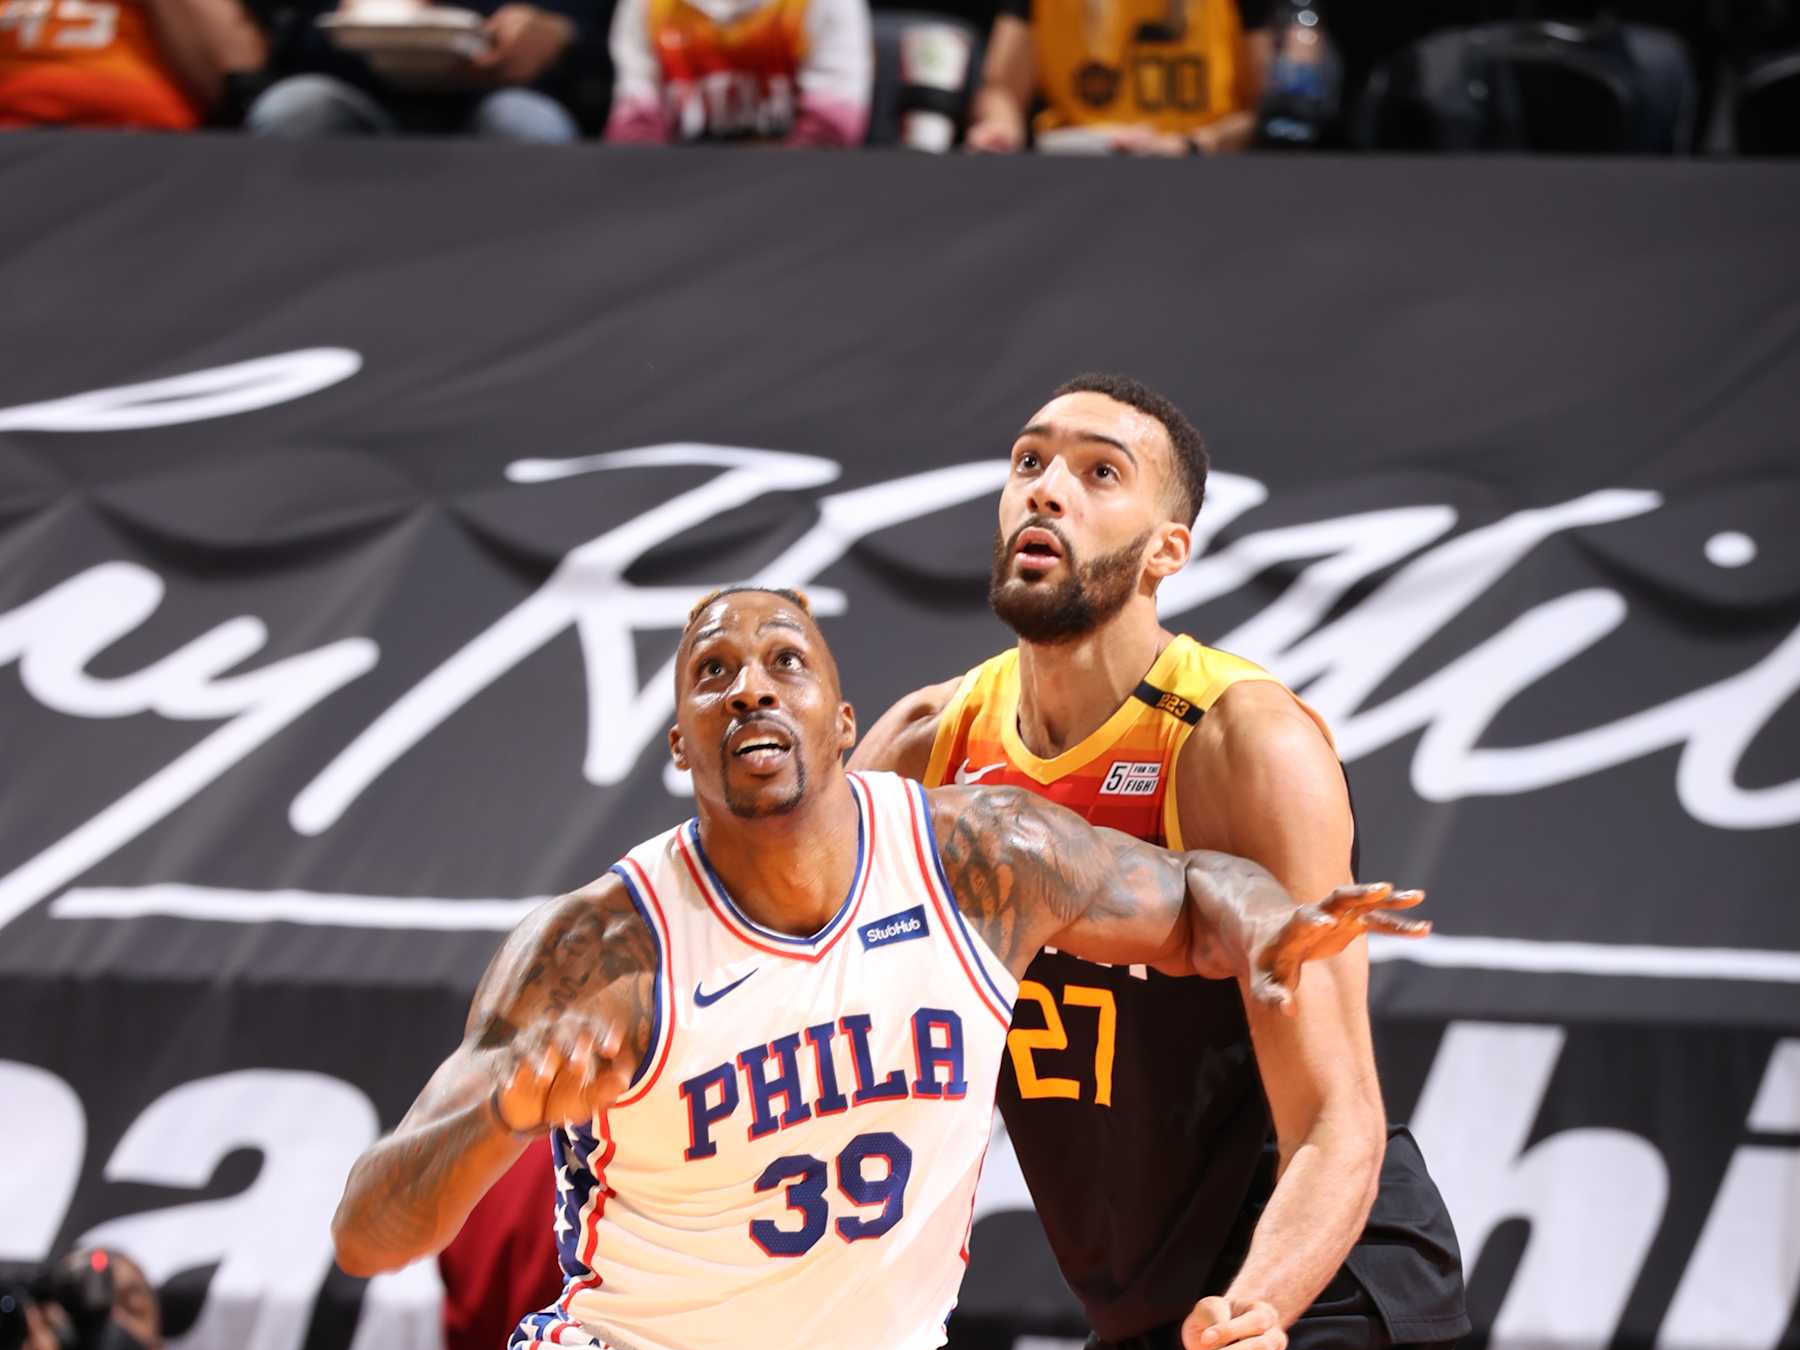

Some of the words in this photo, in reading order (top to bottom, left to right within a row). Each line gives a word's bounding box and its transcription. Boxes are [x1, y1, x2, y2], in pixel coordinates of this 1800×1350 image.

[1106, 765, 1128, 791] 5
[1124, 779, 1157, 792] FIGHT
[866, 918, 921, 943] StubHub
[1007, 979, 1117, 1107] 27
[679, 1007, 968, 1163] PHILA
[749, 1131, 912, 1258] 39
